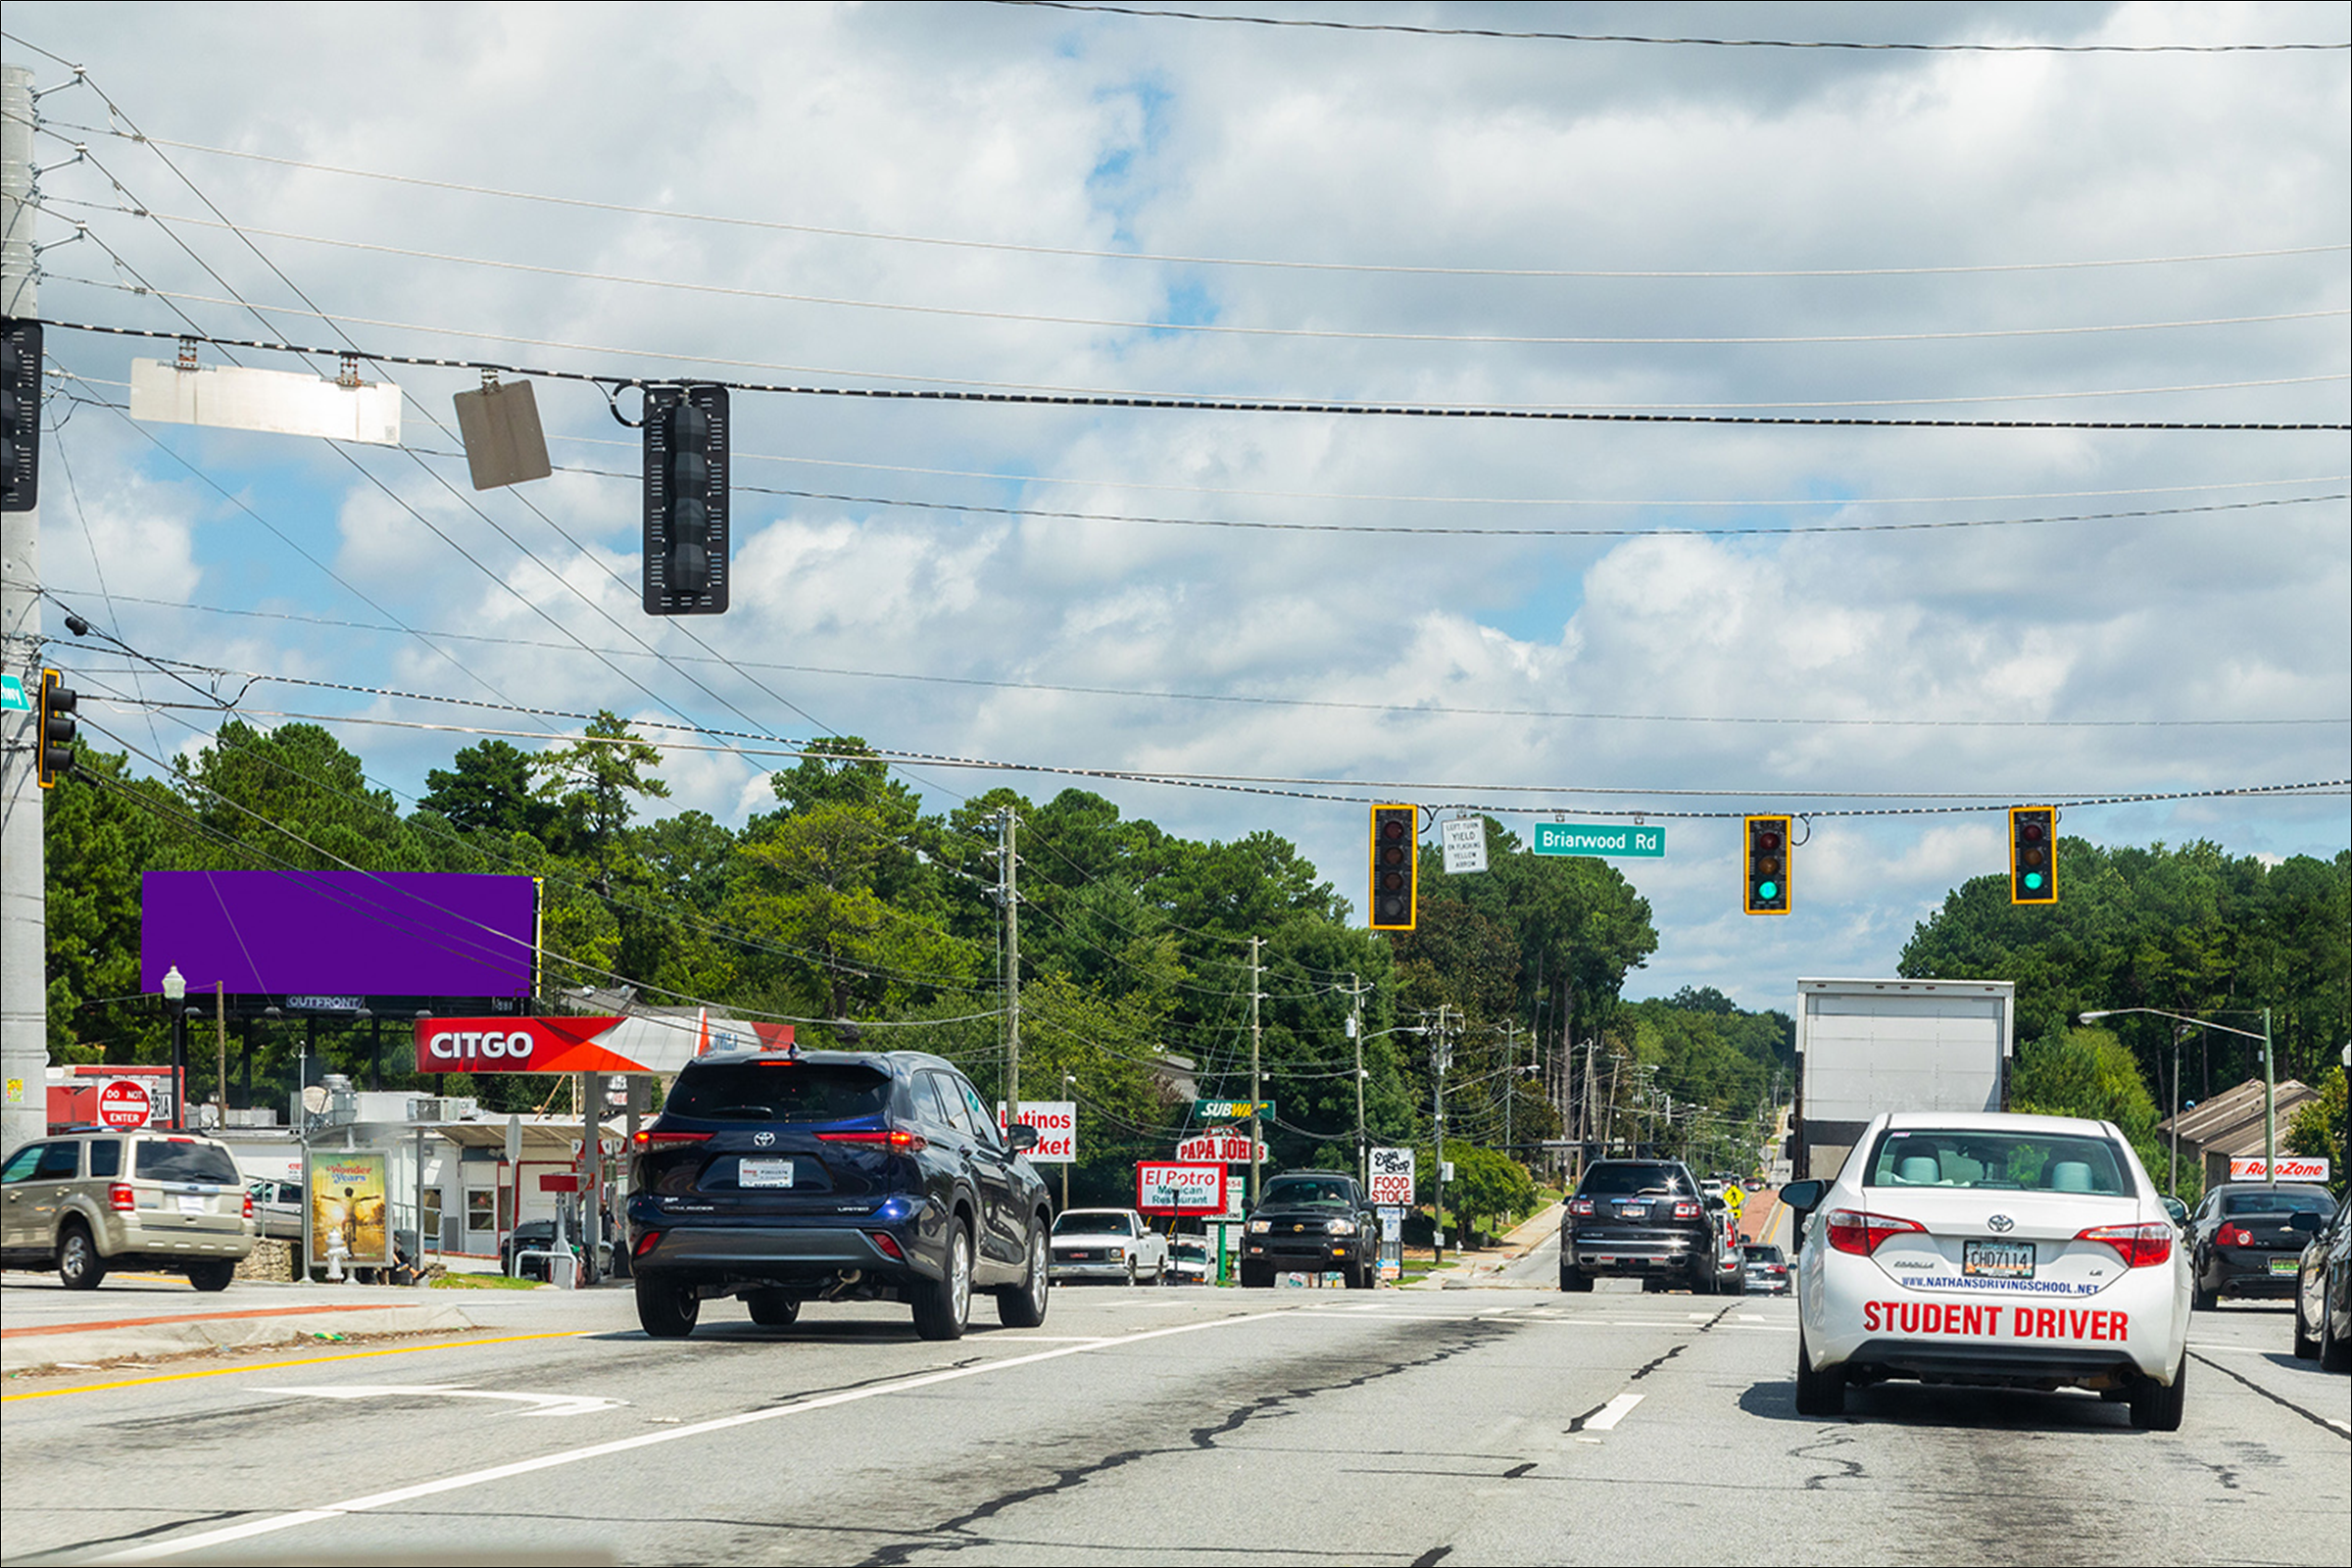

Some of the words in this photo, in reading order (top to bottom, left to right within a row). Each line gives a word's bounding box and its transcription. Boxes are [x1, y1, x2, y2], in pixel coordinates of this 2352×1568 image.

[1451, 831, 1475, 841] YIELD
[1543, 830, 1626, 849] Briarwood
[1636, 833, 1657, 850] Rd
[289, 997, 361, 1009] OUTFRONT
[429, 1031, 534, 1058] CITGO
[106, 1089, 120, 1100] DO
[126, 1090, 143, 1101] NOT
[1200, 1102, 1269, 1117] SUBWA
[109, 1112, 140, 1123] ENTER
[1001, 1109, 1071, 1129] Ltinos
[1180, 1139, 1216, 1159] PAPA
[326, 1162, 372, 1174] Wonder
[2245, 1161, 2324, 1176] AuoZone
[1145, 1169, 1161, 1185] El
[1166, 1170, 1215, 1186] Potro
[1374, 1176, 1410, 1189] FOOD
[1157, 1185, 1203, 1195] Meican
[1863, 1300, 2003, 1336] STUDENT
[2014, 1306, 2129, 1342] DRIVER
